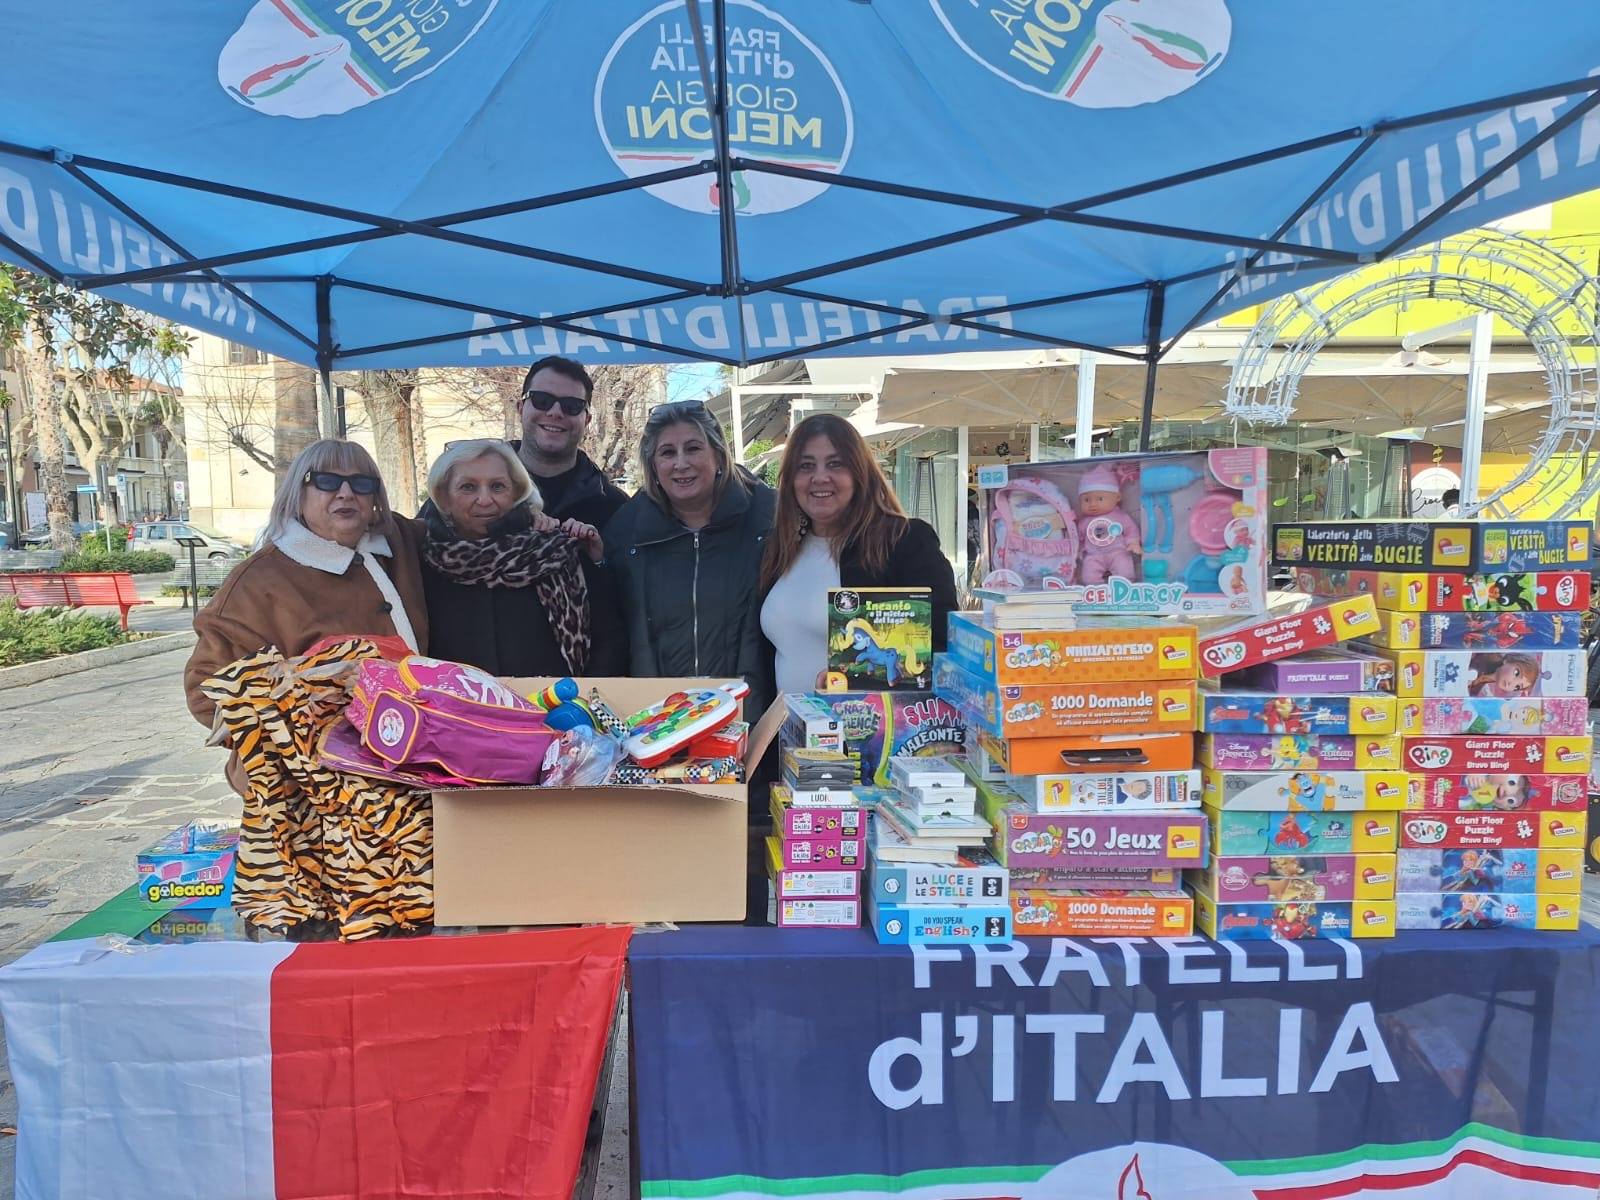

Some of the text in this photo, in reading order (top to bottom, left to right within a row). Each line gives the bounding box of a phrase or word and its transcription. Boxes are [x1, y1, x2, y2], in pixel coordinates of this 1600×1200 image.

[1308, 530, 1350, 540] Laboratorio
[1353, 529, 1373, 540] della
[1308, 541, 1358, 562] VERITÀ
[1374, 545, 1424, 564] BUGIE
[1539, 549, 1565, 564] BUGIE
[1112, 578, 1185, 604] DARCY
[866, 600, 911, 610] Incanto
[1254, 619, 1302, 637] Giant Floor
[1005, 638, 1021, 646] 3-6
[1266, 631, 1296, 644] Puzzle
[1206, 644, 1243, 665] Bing
[1051, 690, 1153, 710] 1000 Domande
[833, 703, 875, 715] CRAZY
[1466, 741, 1515, 749] Giant Floor
[1411, 747, 1449, 764] Bing
[1097, 778, 1107, 806] TATTILE
[1455, 817, 1504, 825] Giant Floor
[1067, 826, 1162, 849] 50 Jeux
[1408, 823, 1444, 841] Bing
[1465, 827, 1494, 835] Puzzle
[916, 875, 973, 885] LA LUCE E
[988, 879, 997, 895] 6-10
[149, 882, 224, 901] goleador
[929, 887, 973, 897] STELLE
[1068, 903, 1155, 915] 1000 Domande
[914, 926, 979, 938] English?
[991, 918, 1000, 936] 6-10
[910, 936, 1364, 988] FRATELLI
[868, 1001, 1400, 1110] d'ITALIA
